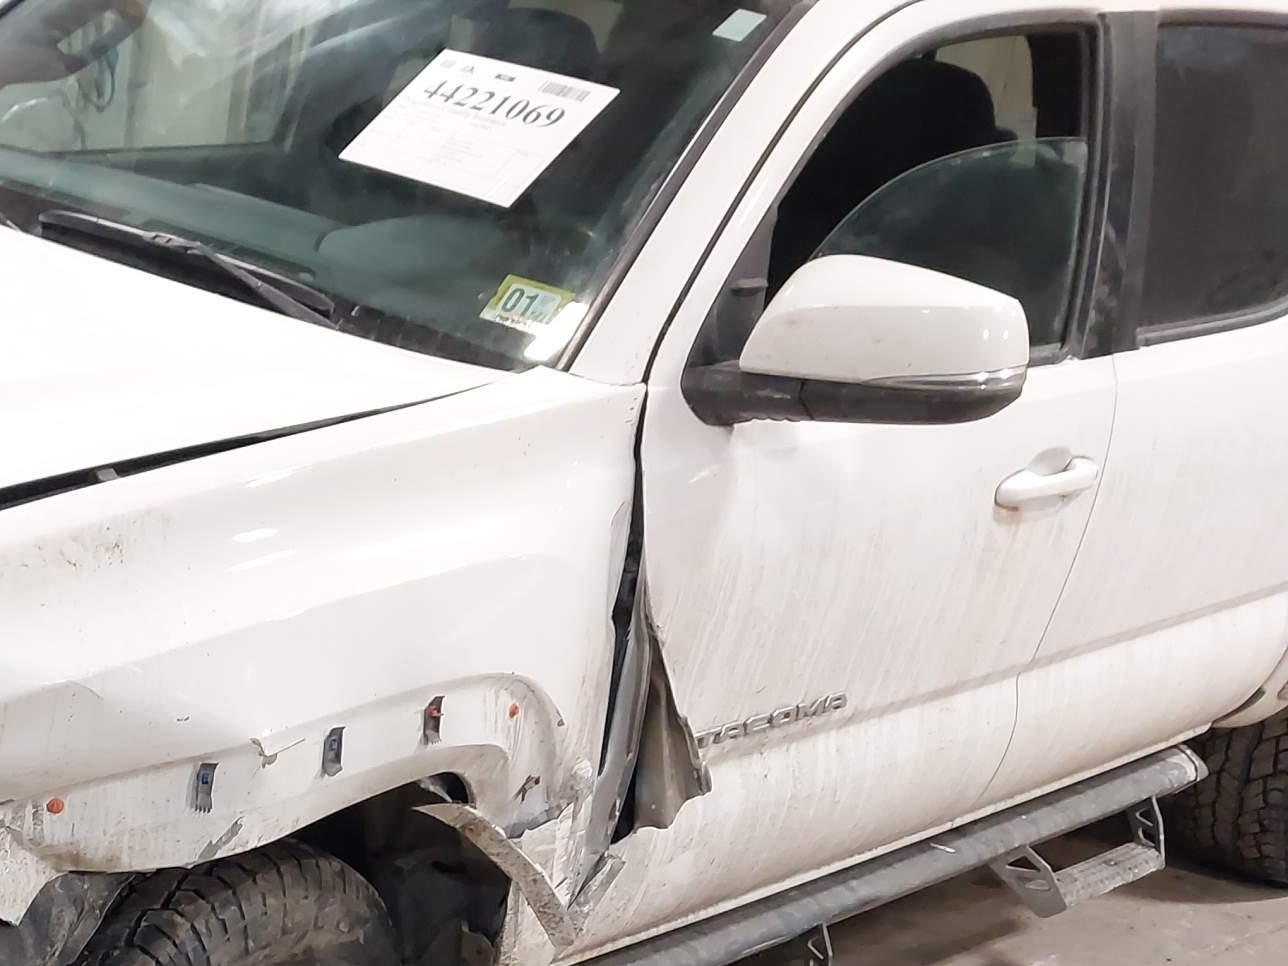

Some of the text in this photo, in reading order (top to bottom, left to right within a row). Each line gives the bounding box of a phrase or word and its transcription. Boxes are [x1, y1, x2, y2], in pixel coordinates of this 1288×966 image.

[423, 80, 566, 128] 44221069
[501, 287, 540, 317] 01
[694, 691, 848, 749] TACOMA
